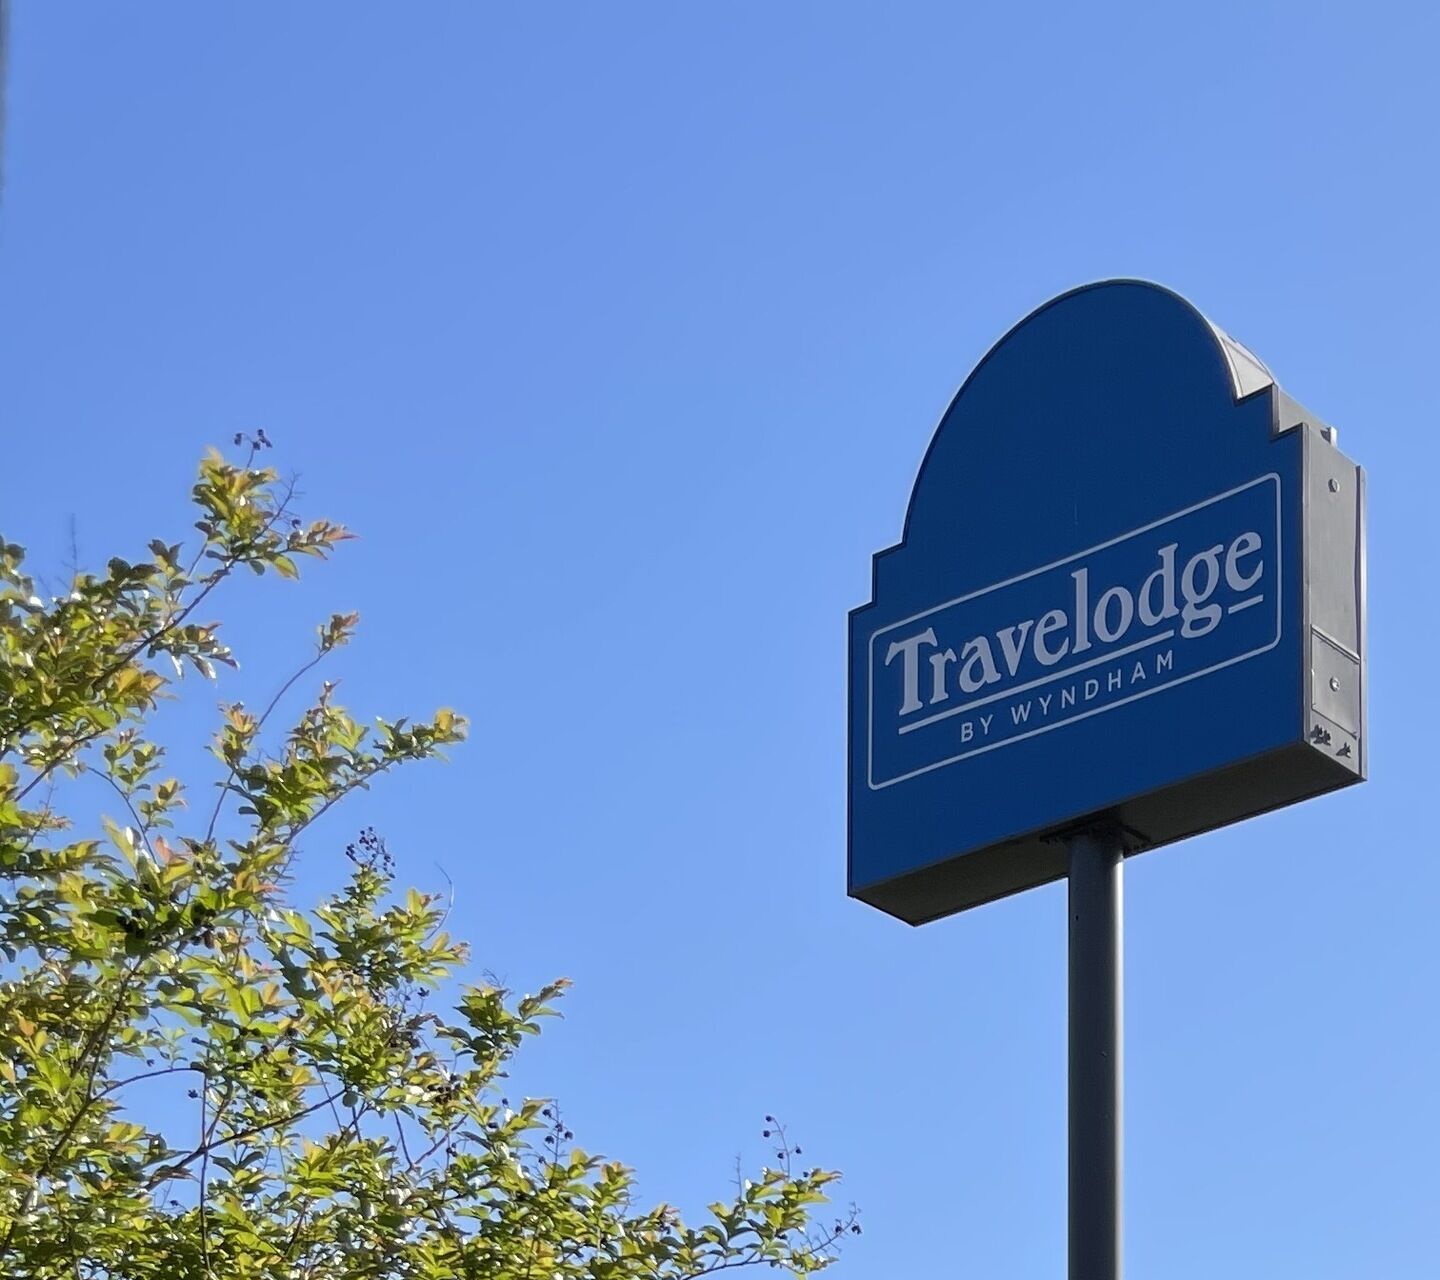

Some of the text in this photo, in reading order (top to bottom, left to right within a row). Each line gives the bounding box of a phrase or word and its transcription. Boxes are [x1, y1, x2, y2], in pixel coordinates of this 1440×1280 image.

[884, 531, 1263, 716] Travelodge
[960, 650, 1173, 743] BY WYNDHAM
